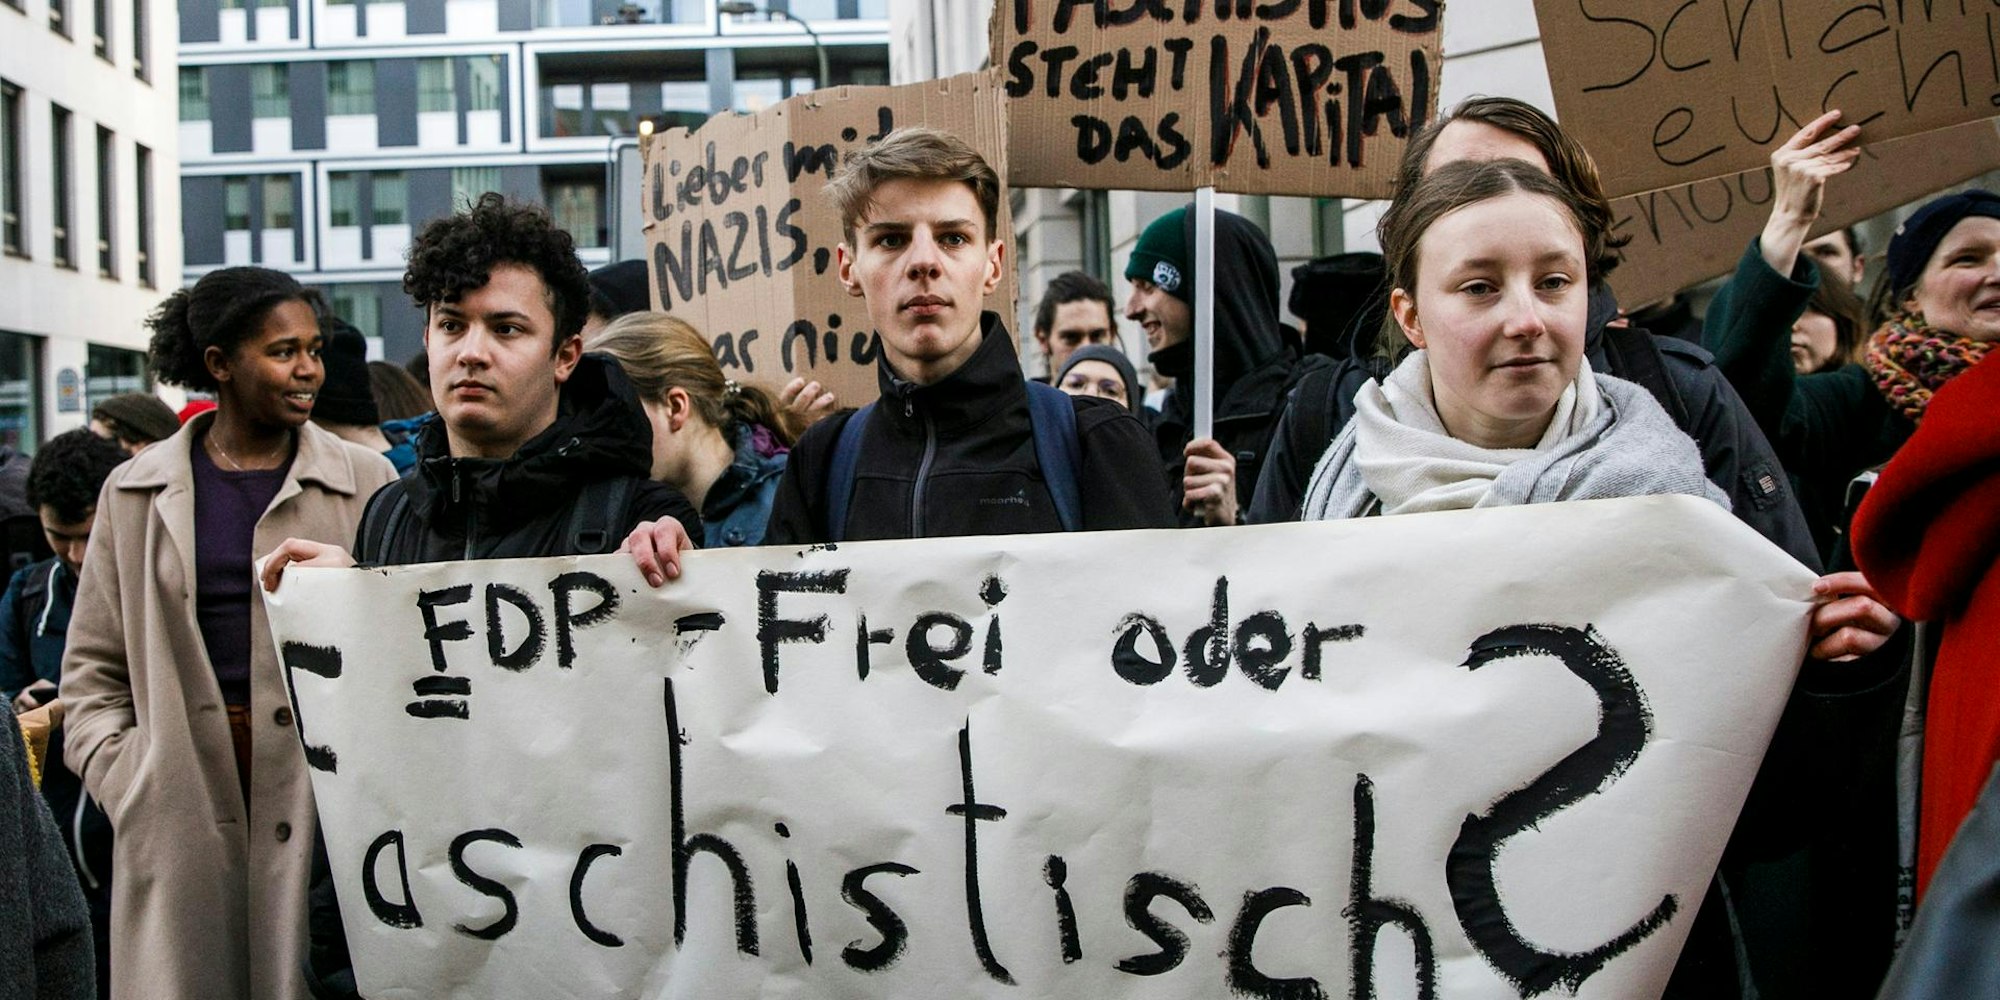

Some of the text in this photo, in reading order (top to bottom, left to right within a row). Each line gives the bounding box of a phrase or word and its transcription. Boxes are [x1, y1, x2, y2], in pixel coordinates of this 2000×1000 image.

[1005, 37, 1194, 101] STEHT
[1071, 112, 1192, 170] DAS
[653, 141, 768, 221] Lieber
[654, 198, 830, 312] NAZIS,
[712, 329, 759, 373] ar
[1112, 576, 1365, 692] oder
